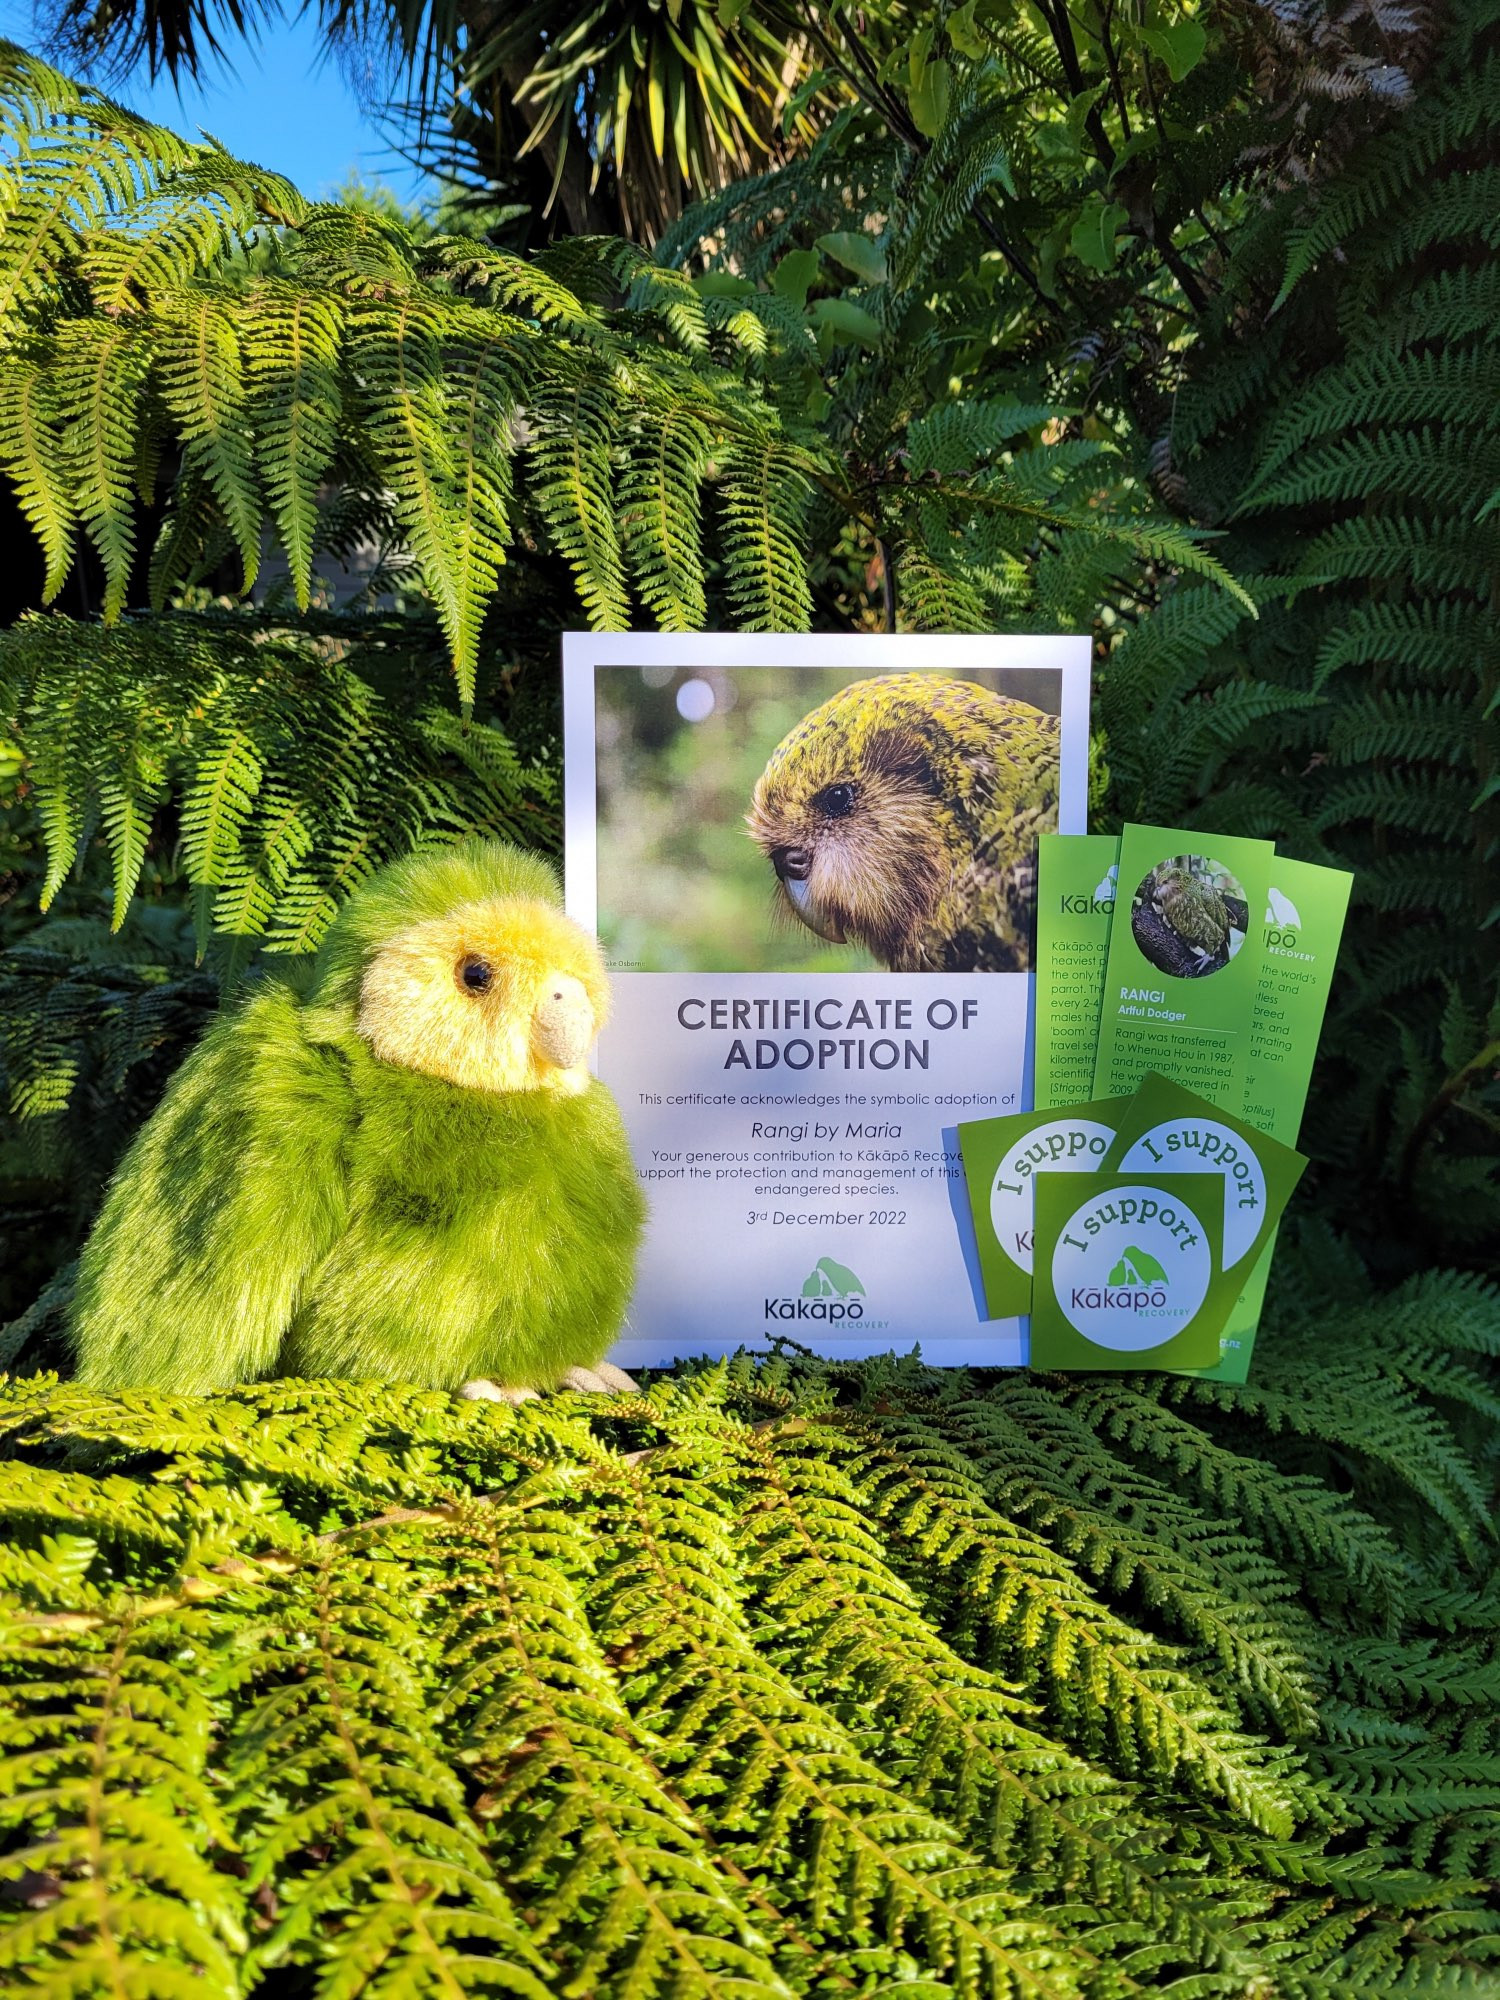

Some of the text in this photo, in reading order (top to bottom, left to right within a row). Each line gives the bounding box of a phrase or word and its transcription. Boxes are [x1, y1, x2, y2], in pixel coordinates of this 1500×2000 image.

[1052, 941, 1109, 954] Kākāpō ar
[1268, 946, 1316, 962] RECOVERY
[1051, 955, 1096, 966] heaviest
[1052, 969, 1069, 980] the
[1072, 969, 1093, 982] only
[1261, 964, 1317, 985] the world's
[1051, 985, 1086, 996] parrot.
[1120, 987, 1165, 1004] RANGI
[1277, 984, 1300, 995] and
[1051, 999, 1080, 1010] every
[1255, 992, 1279, 1005] tless
[677, 998, 978, 1031] CERTIFICATE OF
[1051, 1013, 1082, 1022] males
[1118, 1004, 1187, 1022] Artful Dodger
[1253, 1005, 1285, 1020] breed
[1050, 1027, 1087, 1036] 'boom'
[1268, 1024, 1290, 1035] and
[1051, 1041, 1080, 1050] travel
[1115, 1028, 1146, 1042] Rangi
[1148, 1033, 1168, 1043] was
[1171, 1034, 1227, 1049] transferred
[1255, 1035, 1292, 1052] mating
[723, 1039, 930, 1070] ADOPTION
[1114, 1042, 1235, 1065] to Whenua Hou in 1987,
[1263, 1053, 1284, 1063] can
[1112, 1057, 1235, 1078] and promptly vanished.
[1110, 1070, 1145, 1082] He wa
[1109, 1083, 1133, 1095] 2009
[1220, 1081, 1230, 1091] in
[639, 1093, 1016, 1107] This certificate acknowledges the symbolic adoption of
[1050, 1099, 1084, 1107] mean
[751, 1122, 902, 1142] Rangi by Maria
[1256, 1121, 1274, 1132] soft
[651, 1150, 682, 1162] Your
[686, 1152, 749, 1164] generous
[753, 1150, 835, 1162] contribution
[839, 1151, 853, 1162] to
[857, 1149, 910, 1165] Kākāpō
[997, 1131, 1107, 1195] I suppo
[634, 1167, 685, 1180] support
[689, 1167, 711, 1178] the
[716, 1167, 787, 1180] protection
[791, 1167, 818, 1178] and
[822, 1168, 916, 1182] management
[920, 1167, 934, 1178] of
[938, 1167, 960, 1178] this
[1141, 1130, 1259, 1210] I support
[755, 1183, 899, 1197] endangered species.
[773, 1211, 864, 1225] December
[868, 1211, 907, 1225] 2022
[1062, 1198, 1199, 1253] I support
[1071, 1287, 1191, 1318] Kākāpō RECOVERY
[765, 1298, 889, 1329] Kākāpō RECOVERY
